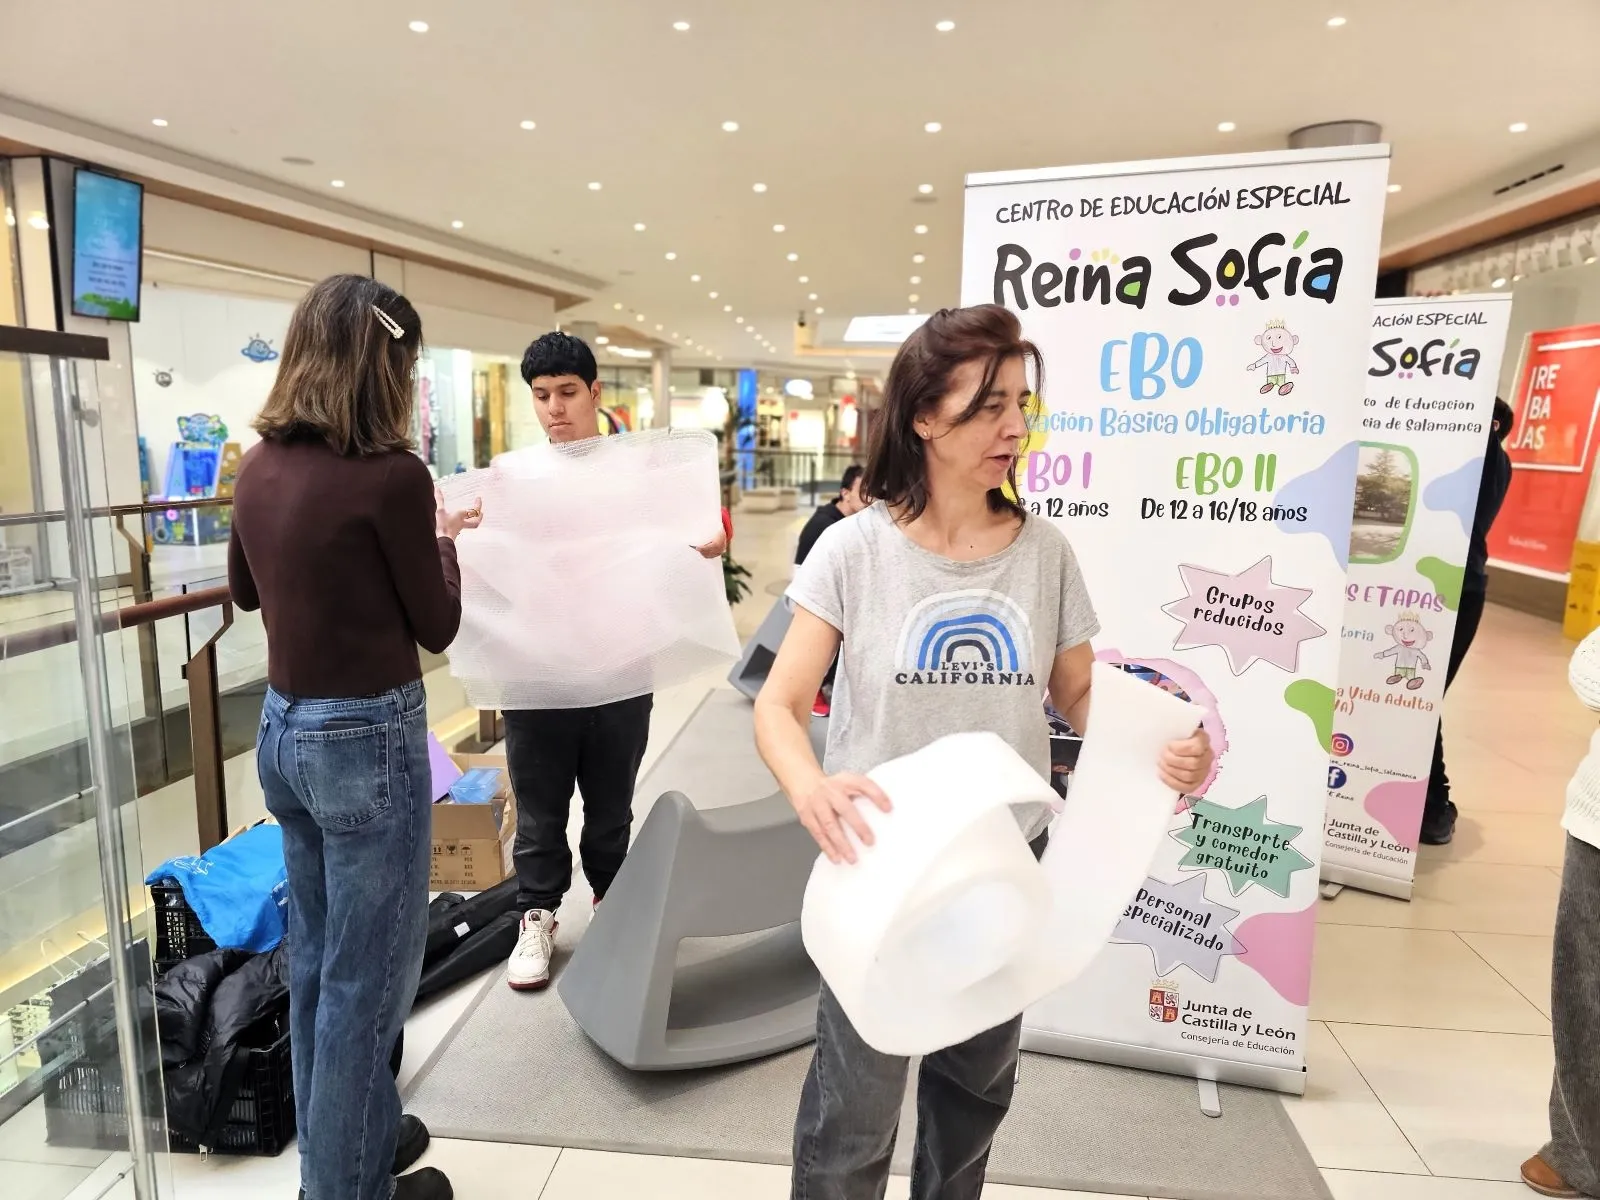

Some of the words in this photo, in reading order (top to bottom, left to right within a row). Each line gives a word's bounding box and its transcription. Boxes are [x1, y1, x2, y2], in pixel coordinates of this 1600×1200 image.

[996, 199, 1073, 223] CENTRO
[1080, 197, 1103, 218] DE
[1110, 187, 1230, 217] EDUCACIÓN
[1237, 181, 1351, 211] ESPECIAL
[993, 243, 1151, 310] Reina
[1168, 230, 1343, 306] Sofía
[1372, 314, 1413, 327] ACIÓN
[1417, 312, 1488, 326] ESPECIAL
[1100, 332, 1203, 400] EBO
[1368, 337, 1481, 380] Sofía
[1364, 397, 1376, 407] co
[1385, 396, 1400, 409] de
[1529, 394, 1551, 420] BA
[1040, 410, 1093, 433] ación
[1100, 408, 1178, 437] Básica
[1186, 407, 1326, 438] Obligatoria
[1363, 418, 1381, 430] cia
[1385, 417, 1401, 430] de
[1405, 418, 1483, 433] Salamanca
[1016, 450, 1072, 493] BO
[1083, 451, 1092, 490] I
[1176, 452, 1244, 495] EBO
[1255, 453, 1277, 492] II
[1046, 498, 1063, 517] 12
[1068, 501, 1109, 517] años
[1141, 499, 1165, 520] De
[1170, 499, 1189, 521] 12
[1193, 505, 1203, 519] a
[1209, 497, 1257, 522] 16/18
[1262, 500, 1307, 522] años
[1206, 586, 1274, 614] Grupos
[1364, 585, 1446, 612] ETAPAS
[1194, 607, 1284, 635] reducidos
[1341, 626, 1374, 641] toria
[895, 672, 1035, 685] CALIFORNIA
[941, 661, 995, 671] LEVI'S
[1349, 686, 1380, 703] Vida
[1385, 693, 1433, 712] Adulta
[1190, 812, 1290, 851] Transporte
[1329, 818, 1362, 832] Junta
[1365, 825, 1380, 836] de
[1195, 834, 1206, 847] y
[1212, 838, 1279, 864] comedor
[1327, 828, 1367, 845] Castilla
[1370, 838, 1378, 848] y
[1381, 840, 1410, 854] León
[1196, 852, 1268, 879] gratuito
[1362, 848, 1371, 856] de
[1373, 852, 1408, 865] Educación
[1123, 905, 1224, 951] specializado
[1183, 1000, 1227, 1016] Junta
[1232, 1007, 1252, 1019] de
[1182, 1014, 1237, 1032] Castilla
[1241, 1025, 1251, 1036] y
[1256, 1024, 1296, 1041] León
[1181, 1031, 1230, 1046] Consejería
[1232, 1039, 1244, 1048] de
[1247, 1041, 1295, 1055] Educación
